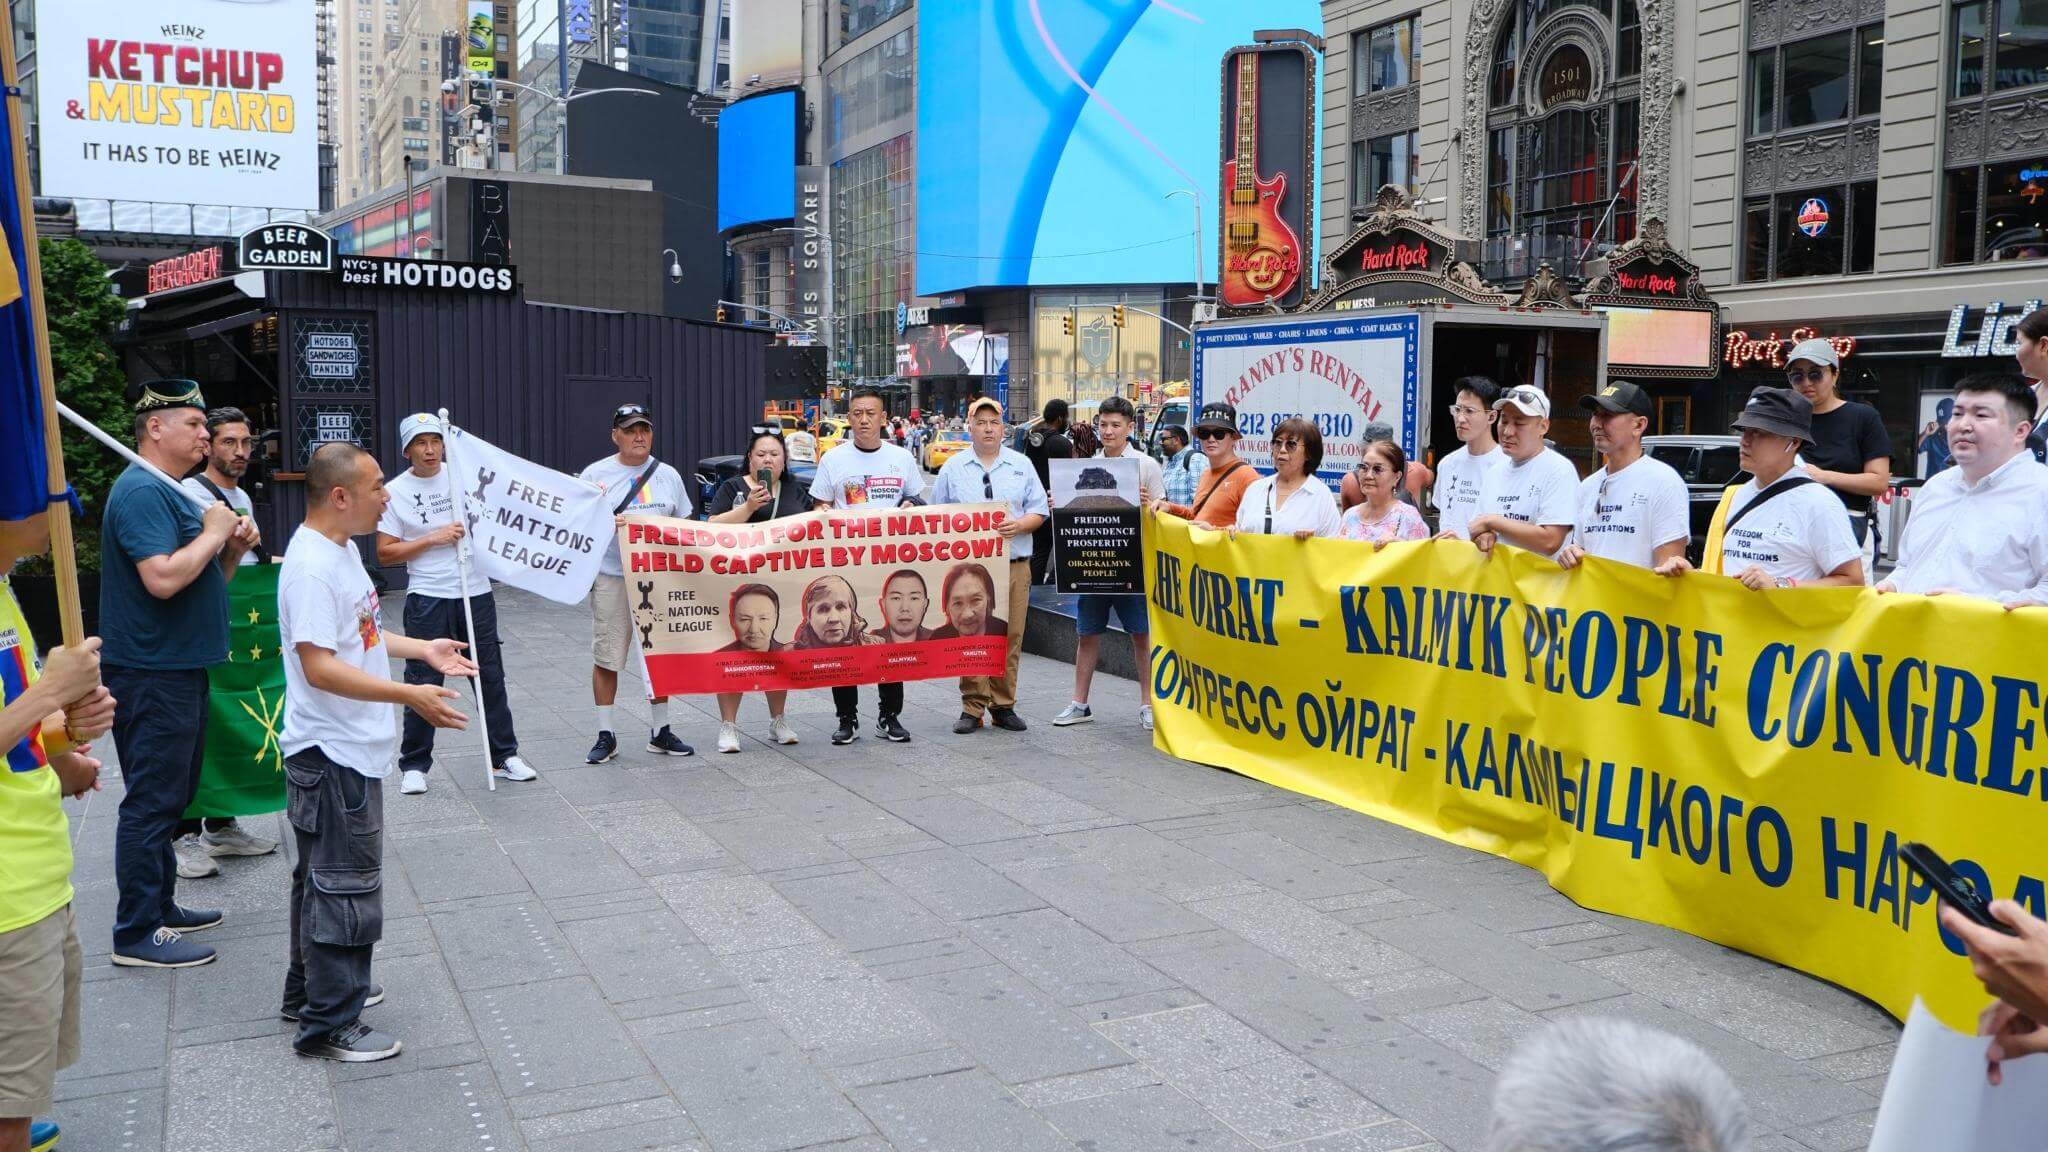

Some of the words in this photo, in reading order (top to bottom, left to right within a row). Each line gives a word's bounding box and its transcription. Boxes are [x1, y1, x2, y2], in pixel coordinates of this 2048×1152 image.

[161, 24, 205, 39] HEINZ
[87, 38, 283, 90] KETCHUP
[1553, 66, 1581, 85] 1501
[1547, 88, 1585, 105] BROADWAY
[66, 99, 85, 120] &
[88, 80, 295, 134] MUSTARD
[83, 142, 100, 160] IT
[108, 145, 148, 163] HAS
[155, 147, 181, 165] TO
[189, 149, 210, 166] BE
[219, 149, 281, 171] HEINZ
[804, 183, 818, 269] SQUARE
[263, 227, 308, 246] BEER
[249, 248, 322, 266] GARDEN
[342, 259, 378, 270] NYC's
[1229, 255, 1264, 272] Hard
[1265, 255, 1298, 274] Rock
[1362, 244, 1395, 270] Hard
[1397, 241, 1428, 270] Rock
[342, 270, 377, 285] best
[383, 262, 513, 291] HOTDOGS
[1619, 271, 1647, 289] Hard
[1649, 273, 1677, 294] Rock
[804, 291, 818, 342] IMES
[1206, 335, 1223, 343] PARTY
[1224, 334, 1247, 342] RENTALS
[1253, 331, 1273, 339] TABLES
[1278, 330, 1300, 338] CHAIRS
[1306, 328, 1328, 337] LINENS
[1334, 327, 1354, 335] CHINA
[1942, 300, 2042, 357] Lid
[314, 337, 349, 348] HOTDOGS
[1725, 329, 1784, 368] Rock
[1787, 327, 1856, 359] Sp
[309, 351, 355, 361] SANDWICHES
[314, 365, 350, 375] PANINIS
[1224, 347, 1304, 405] RANNY'S
[322, 417, 348, 427] BEER
[1239, 412, 1265, 436] 212
[322, 431, 348, 440] WINE
[506, 479, 565, 514] FREE
[1074, 516, 1120, 524] FREEDOM
[1608, 525, 1635, 533] ATIONS
[496, 507, 595, 553] NATIONS
[628, 523, 765, 549] FREEDOM
[770, 520, 824, 544] FOR
[829, 517, 882, 539] THE
[888, 510, 1006, 537] NATIONS
[1060, 528, 1135, 536] INDEPENDENCE
[1731, 529, 1763, 539] FREEDOM
[1067, 539, 1129, 547] PROSPERITY
[1738, 540, 1751, 548] FOR
[488, 536, 572, 576] LEAGUE
[631, 551, 704, 573] HELD
[710, 548, 825, 575] CAPTIVE
[831, 544, 866, 567] BY
[871, 537, 1003, 565] MOSCOW!
[1067, 560, 1131, 568] OIRAT-KALMYK
[1742, 551, 1779, 561] NATIONS
[668, 590, 696, 602] FREE
[668, 605, 720, 618] NATIONS
[668, 620, 713, 633] LEAGUE
[1153, 550, 1184, 618] HE
[1189, 563, 1283, 646] OIRAT
[1340, 585, 1511, 678] KALMYK
[1523, 602, 1723, 728] PEOPLE
[1747, 642, 2048, 802] CONGRE
